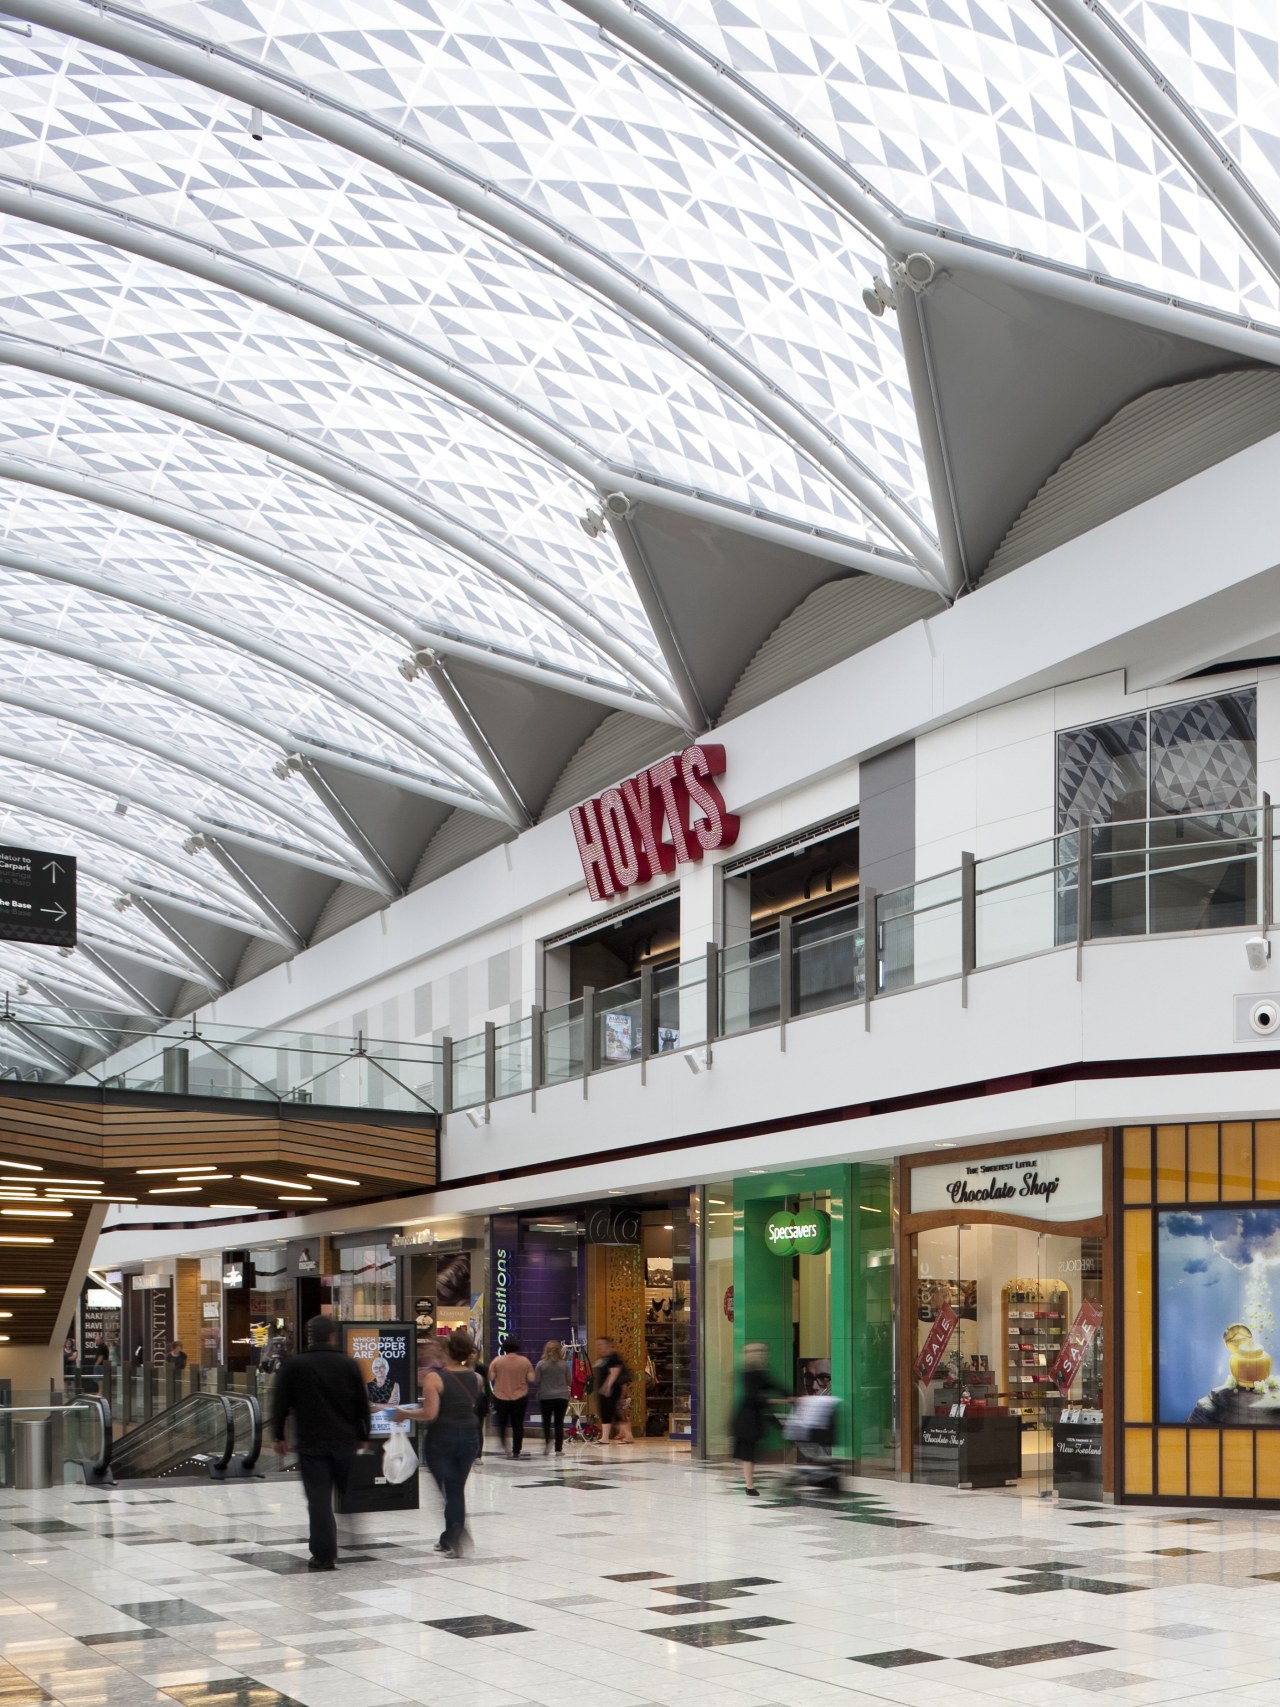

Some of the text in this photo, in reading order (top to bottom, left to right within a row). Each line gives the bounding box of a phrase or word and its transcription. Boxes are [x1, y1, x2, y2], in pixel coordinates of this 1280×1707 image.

[569, 745, 734, 902] HOYTS
[12, 901, 32, 909] Base
[946, 1172, 1060, 1203] Chocolate Shop
[768, 1224, 817, 1243] Specsavers
[153, 1289, 167, 1369] IDENTITY
[926, 1317, 951, 1366] SALE
[353, 1342, 406, 1350] SHOPPER
[1062, 1318, 1092, 1373] SALE
[923, 1433, 949, 1444] Chocolate
[1056, 1442, 1102, 1455] New Zealand
